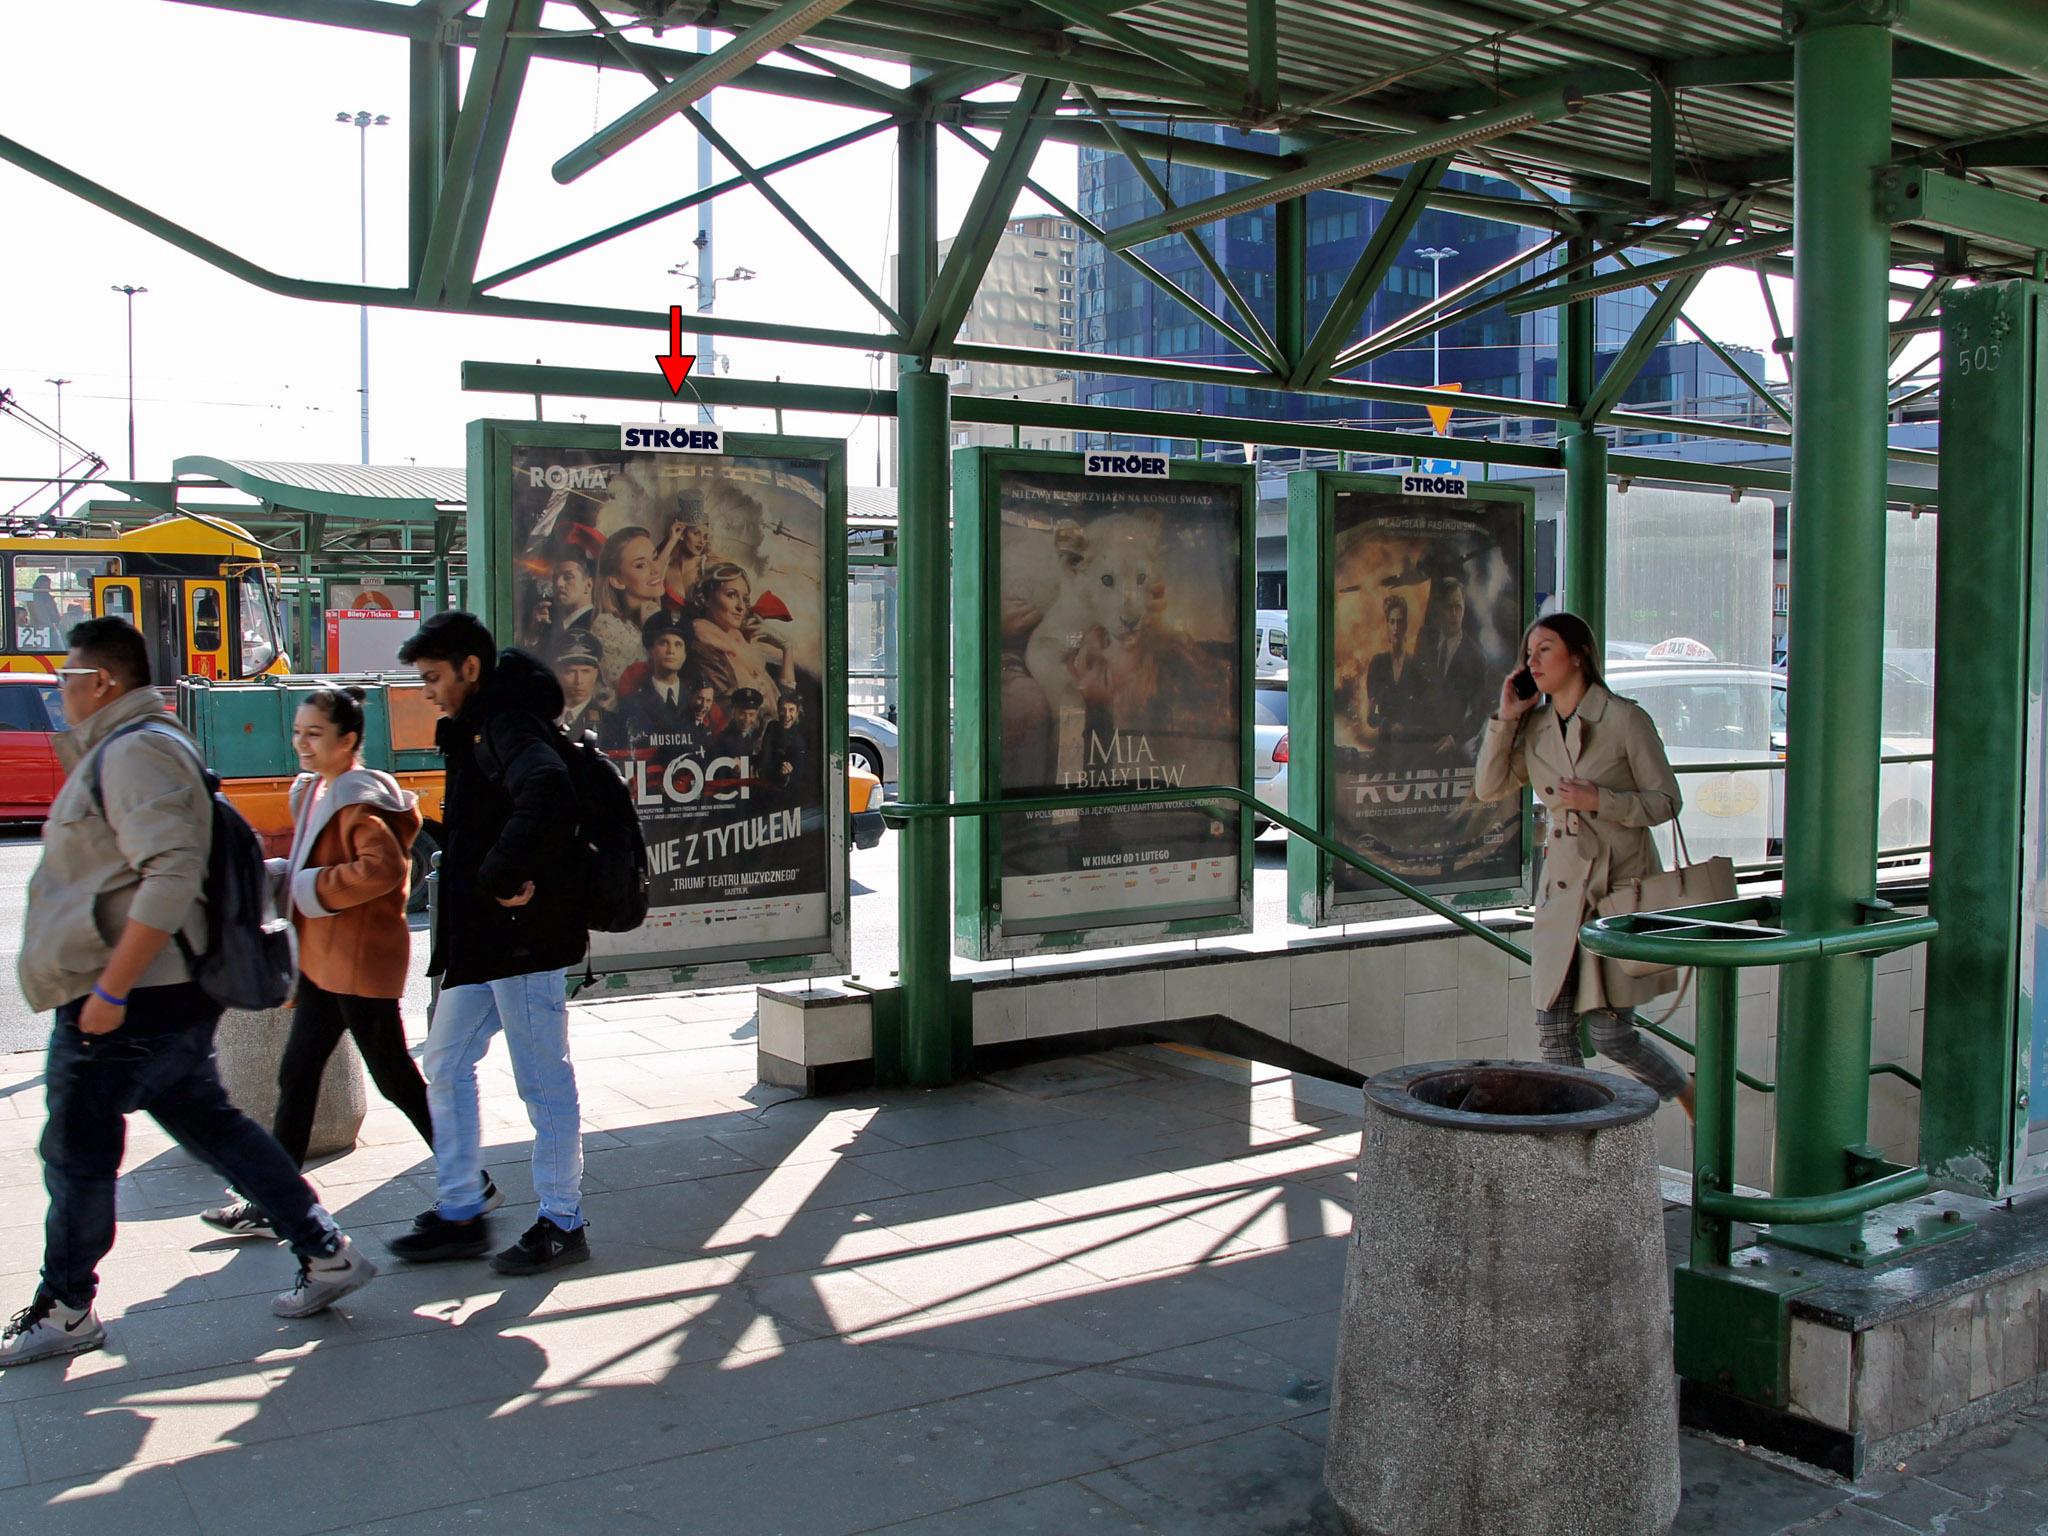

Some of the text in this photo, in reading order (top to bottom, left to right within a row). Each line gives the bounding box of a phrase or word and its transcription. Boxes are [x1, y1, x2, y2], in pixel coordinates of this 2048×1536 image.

[1959, 345, 2001, 375] 503
[625, 427, 719, 449] STRÖER
[1088, 454, 1166, 474] STRÖER
[530, 465, 607, 490] ROMA
[1404, 476, 1465, 495] STRÖER
[22, 628, 45, 646] 25
[650, 733, 693, 746] MUSICAL
[1077, 767, 1131, 789] BIAŁY
[1136, 764, 1186, 791] LEW
[1356, 767, 1476, 804] KURIE
[1131, 801, 1164, 813] MARTYNA
[685, 833, 700, 867] Z
[703, 806, 802, 860] TYTUŁEM
[1082, 857, 1090, 867] W
[1092, 853, 1122, 866] KINACH
[1123, 852, 1134, 863] OD
[1141, 849, 1170, 861] LUTEGO
[708, 874, 740, 888] TEATRU
